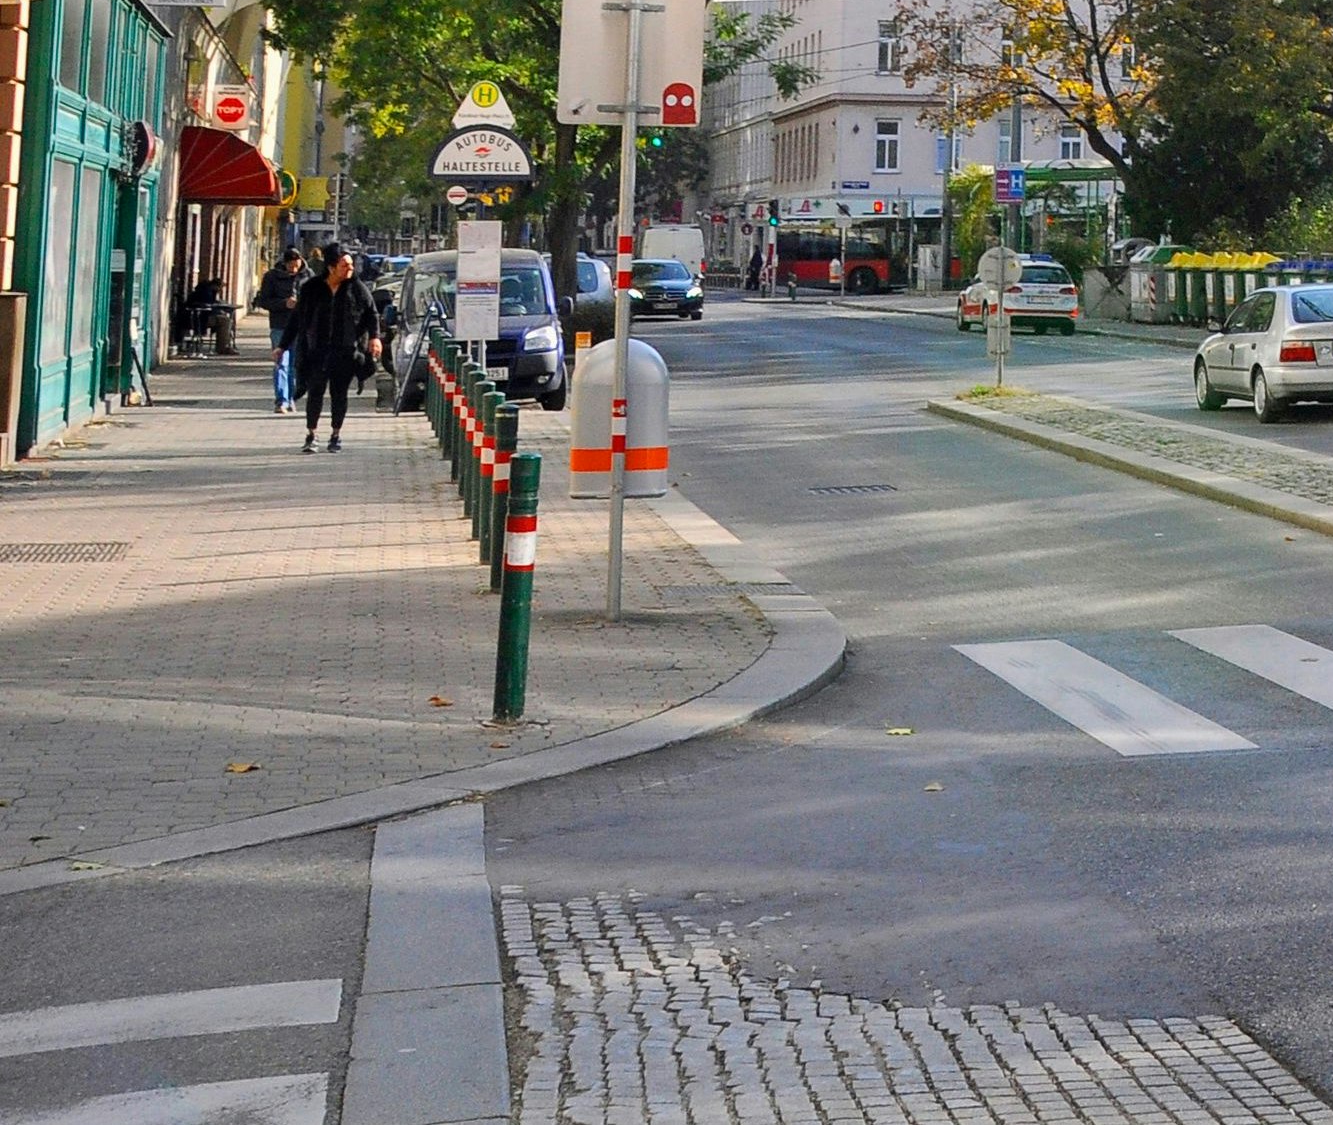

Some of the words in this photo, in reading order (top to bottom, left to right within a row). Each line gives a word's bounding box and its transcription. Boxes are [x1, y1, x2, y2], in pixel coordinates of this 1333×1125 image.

[478, 87, 492, 103] H
[455, 133, 513, 152] AUTOBUS
[442, 161, 521, 172] HALTESTELLE
